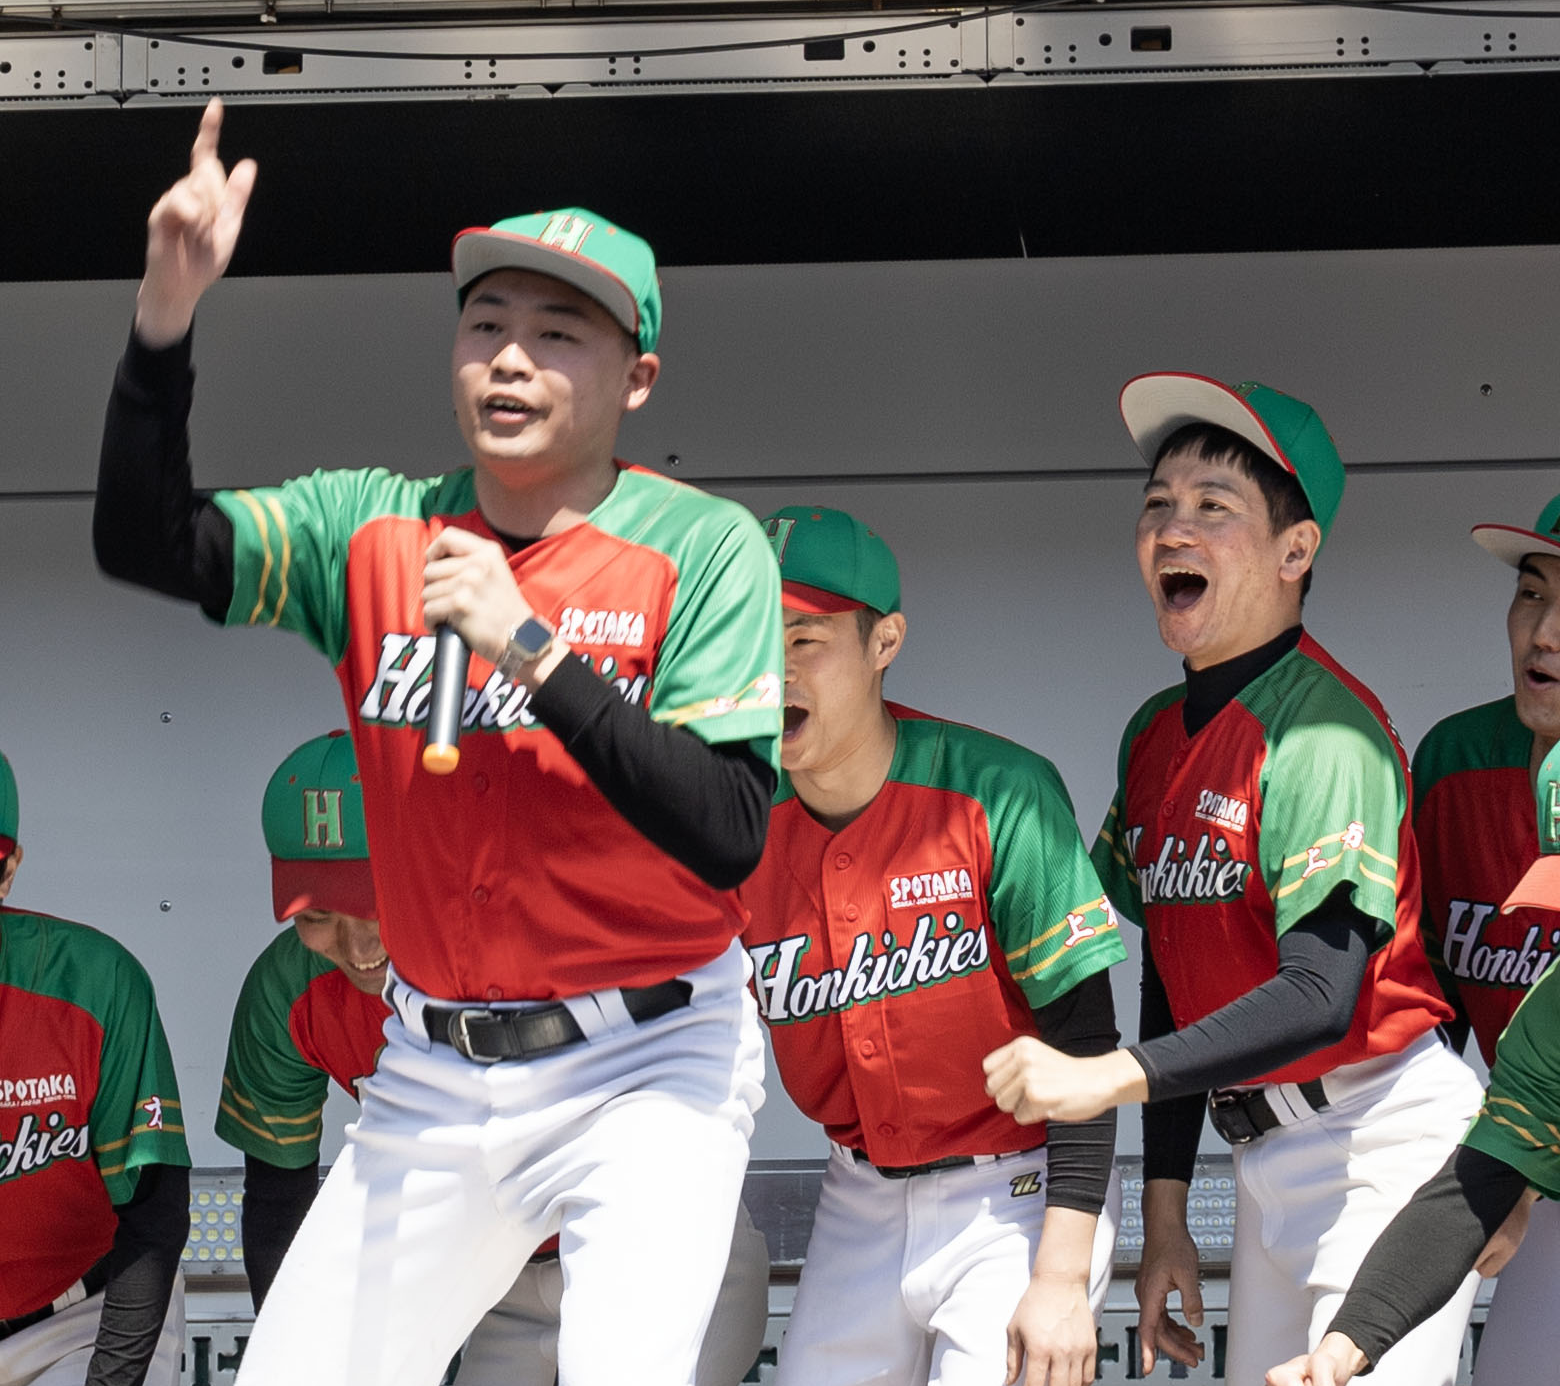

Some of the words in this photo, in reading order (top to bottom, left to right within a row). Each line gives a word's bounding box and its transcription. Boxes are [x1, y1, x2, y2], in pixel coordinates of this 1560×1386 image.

[539, 213, 593, 256] H
[558, 606, 645, 639] SPOTAKA
[302, 789, 344, 849] H
[1196, 789, 1248, 826] SPOTAKA
[890, 868, 972, 902] SPOTAKA
[750, 912, 989, 1024] Honkickies
